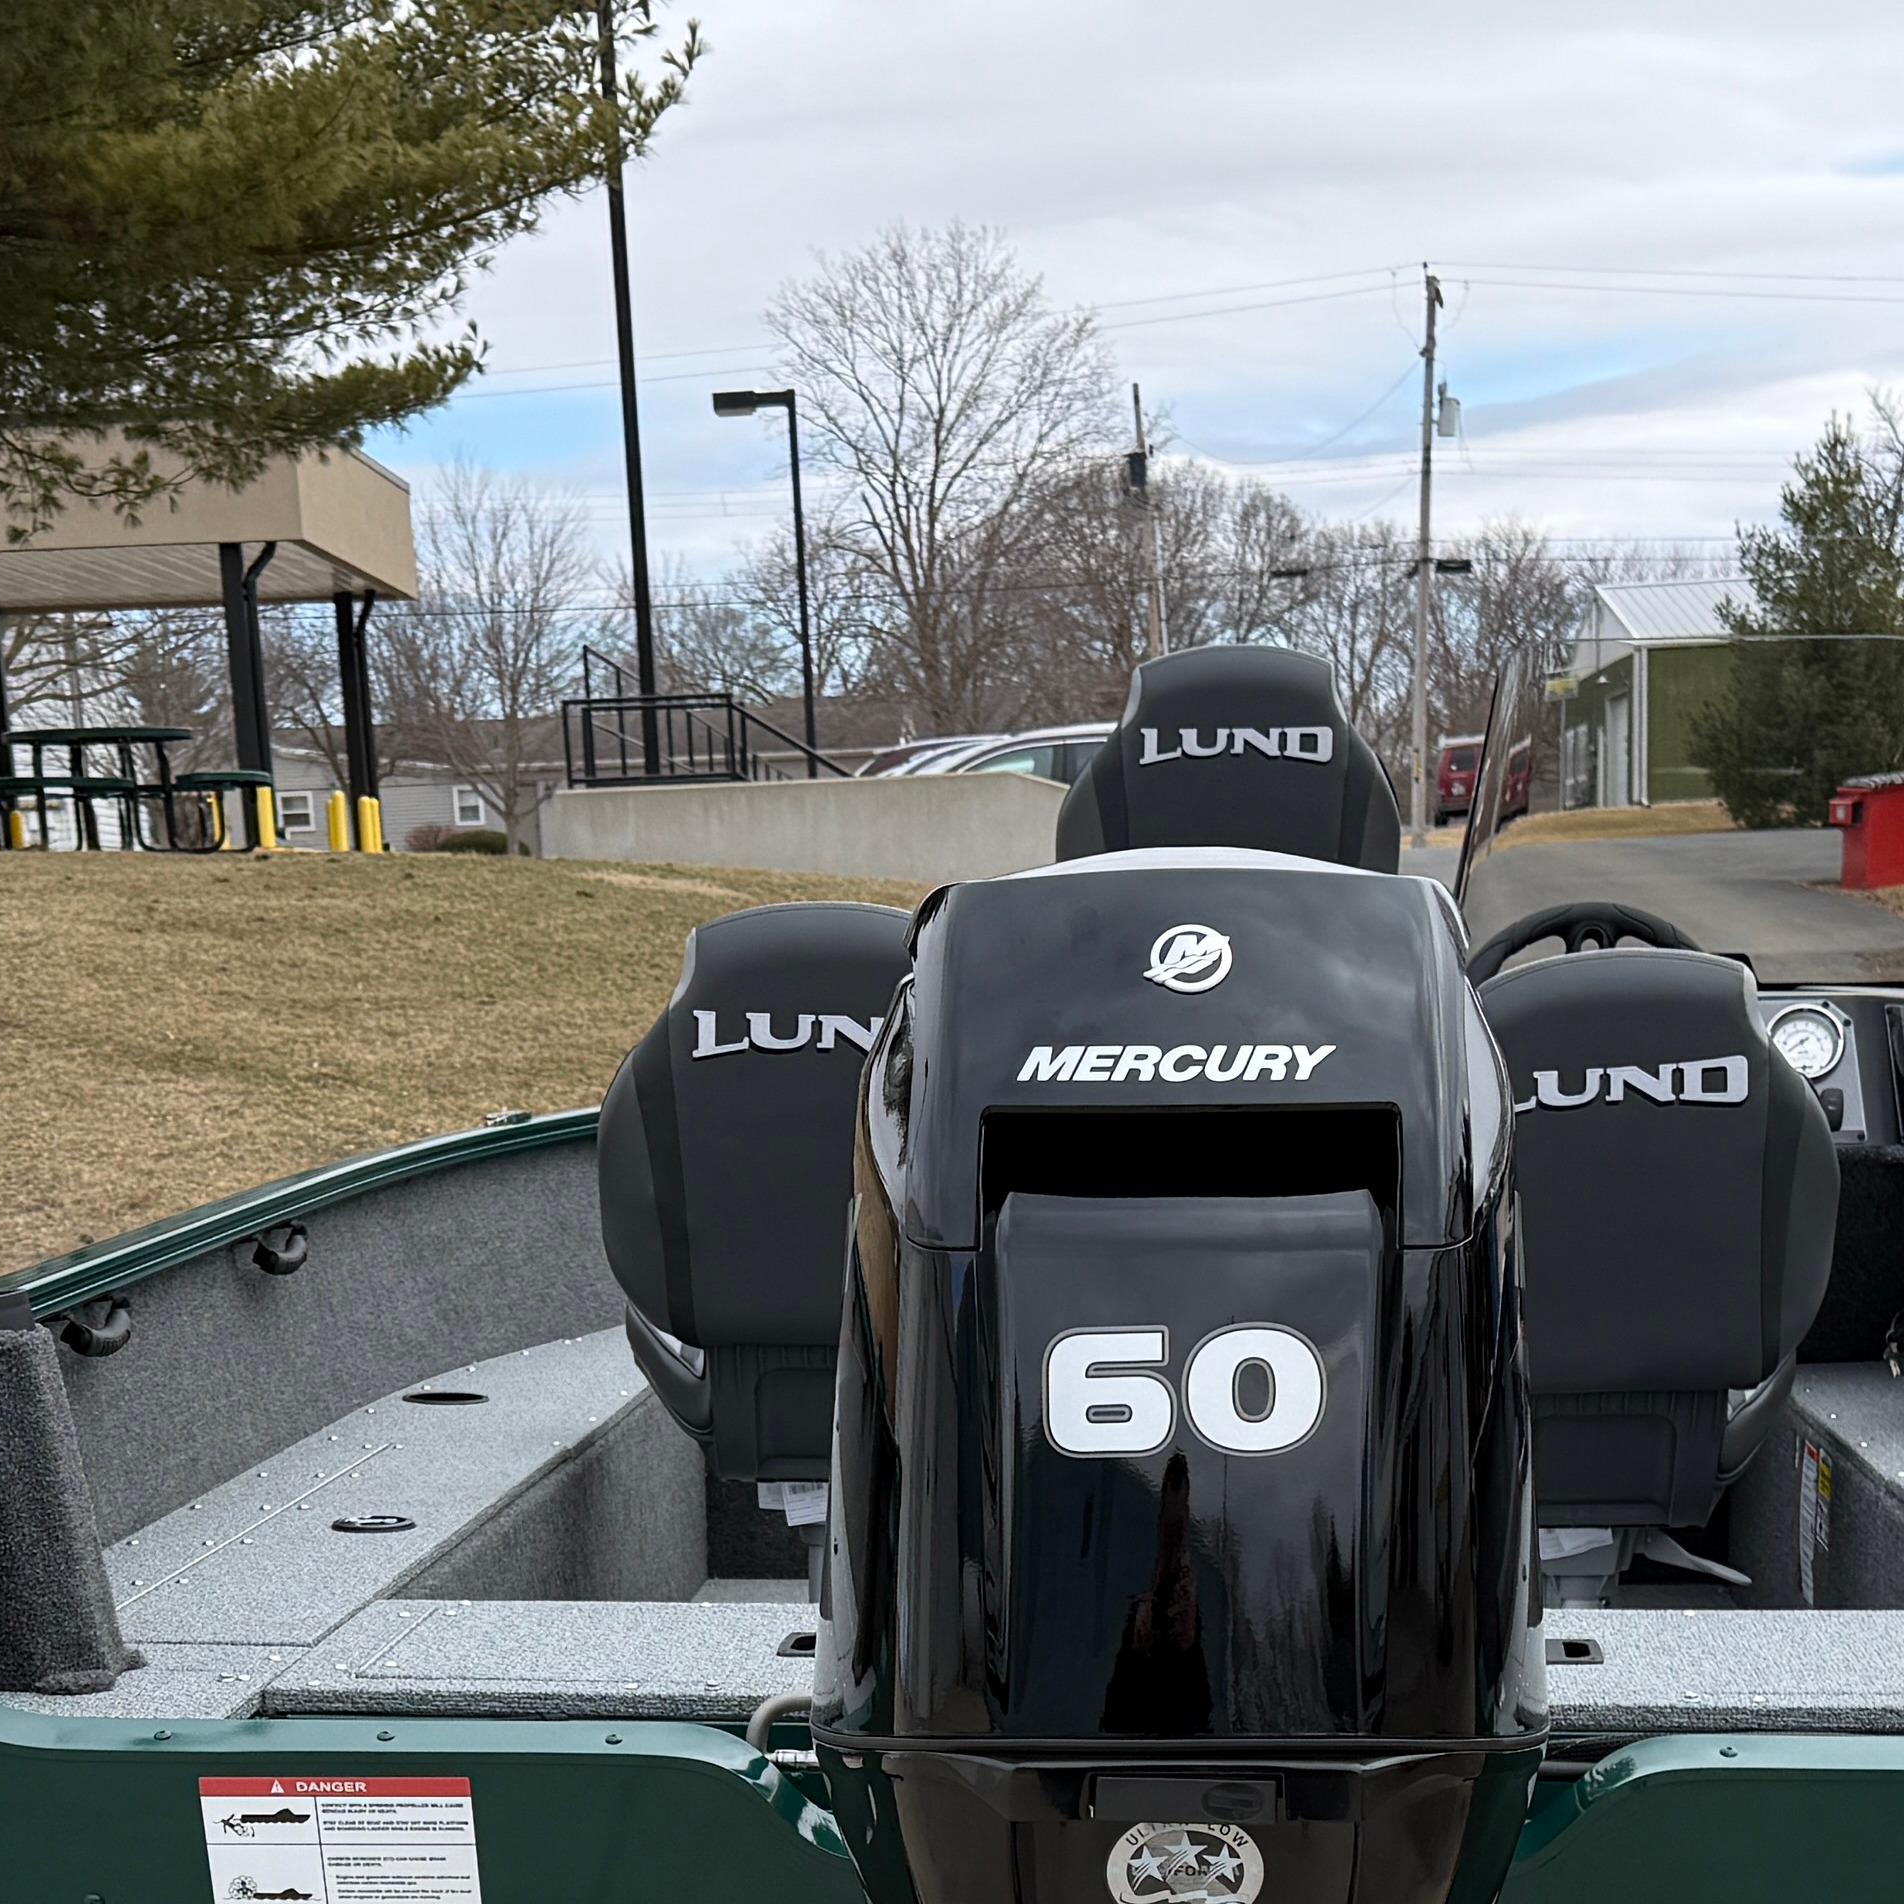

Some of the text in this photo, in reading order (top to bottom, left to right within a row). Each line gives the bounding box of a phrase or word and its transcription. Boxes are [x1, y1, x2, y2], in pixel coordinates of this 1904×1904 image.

[1139, 728, 1333, 764] LUND
[692, 1009, 884, 1058] LUN
[1017, 1044, 1337, 1082] MERCURY
[1044, 1324, 1325, 1456] 60
[295, 1781, 367, 1793] DANGER
